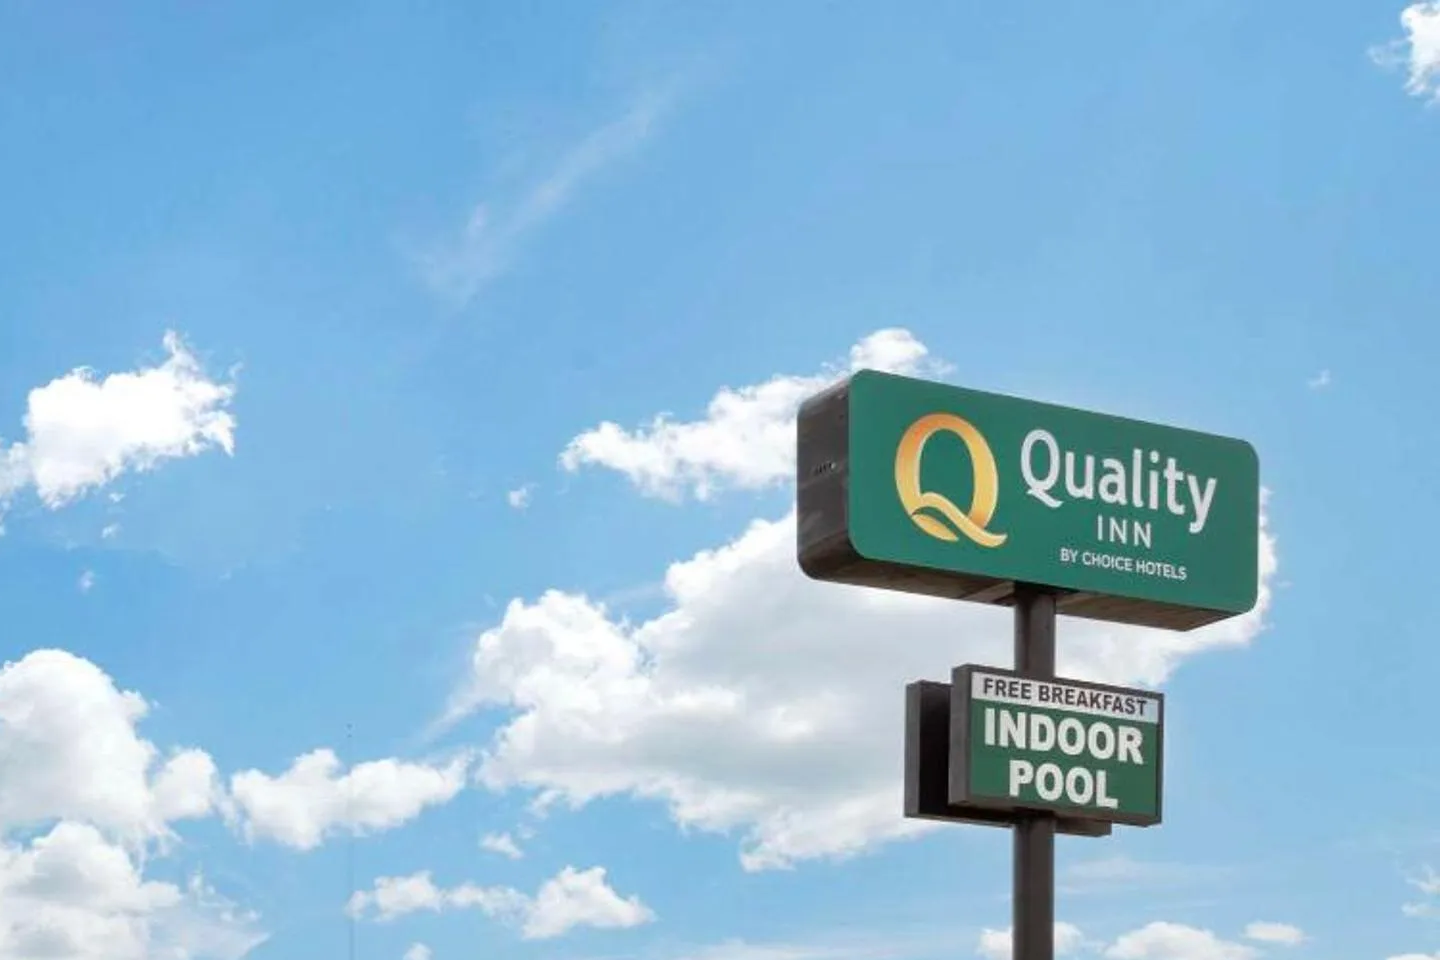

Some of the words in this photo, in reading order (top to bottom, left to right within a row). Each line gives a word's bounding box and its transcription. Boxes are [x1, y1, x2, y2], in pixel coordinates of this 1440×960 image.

[894, 412, 1008, 548] Q
[1020, 429, 1217, 534] Quality
[1097, 514, 1152, 549] INN
[1060, 548, 1078, 563] BY
[1082, 552, 1133, 571] CHOICE
[1136, 561, 1188, 580] HOTELS
[983, 678, 1031, 699] FREE
[1038, 685, 1148, 715] BREAKFAST
[984, 708, 1144, 765] INDOOR
[1009, 760, 1119, 809] POOL
